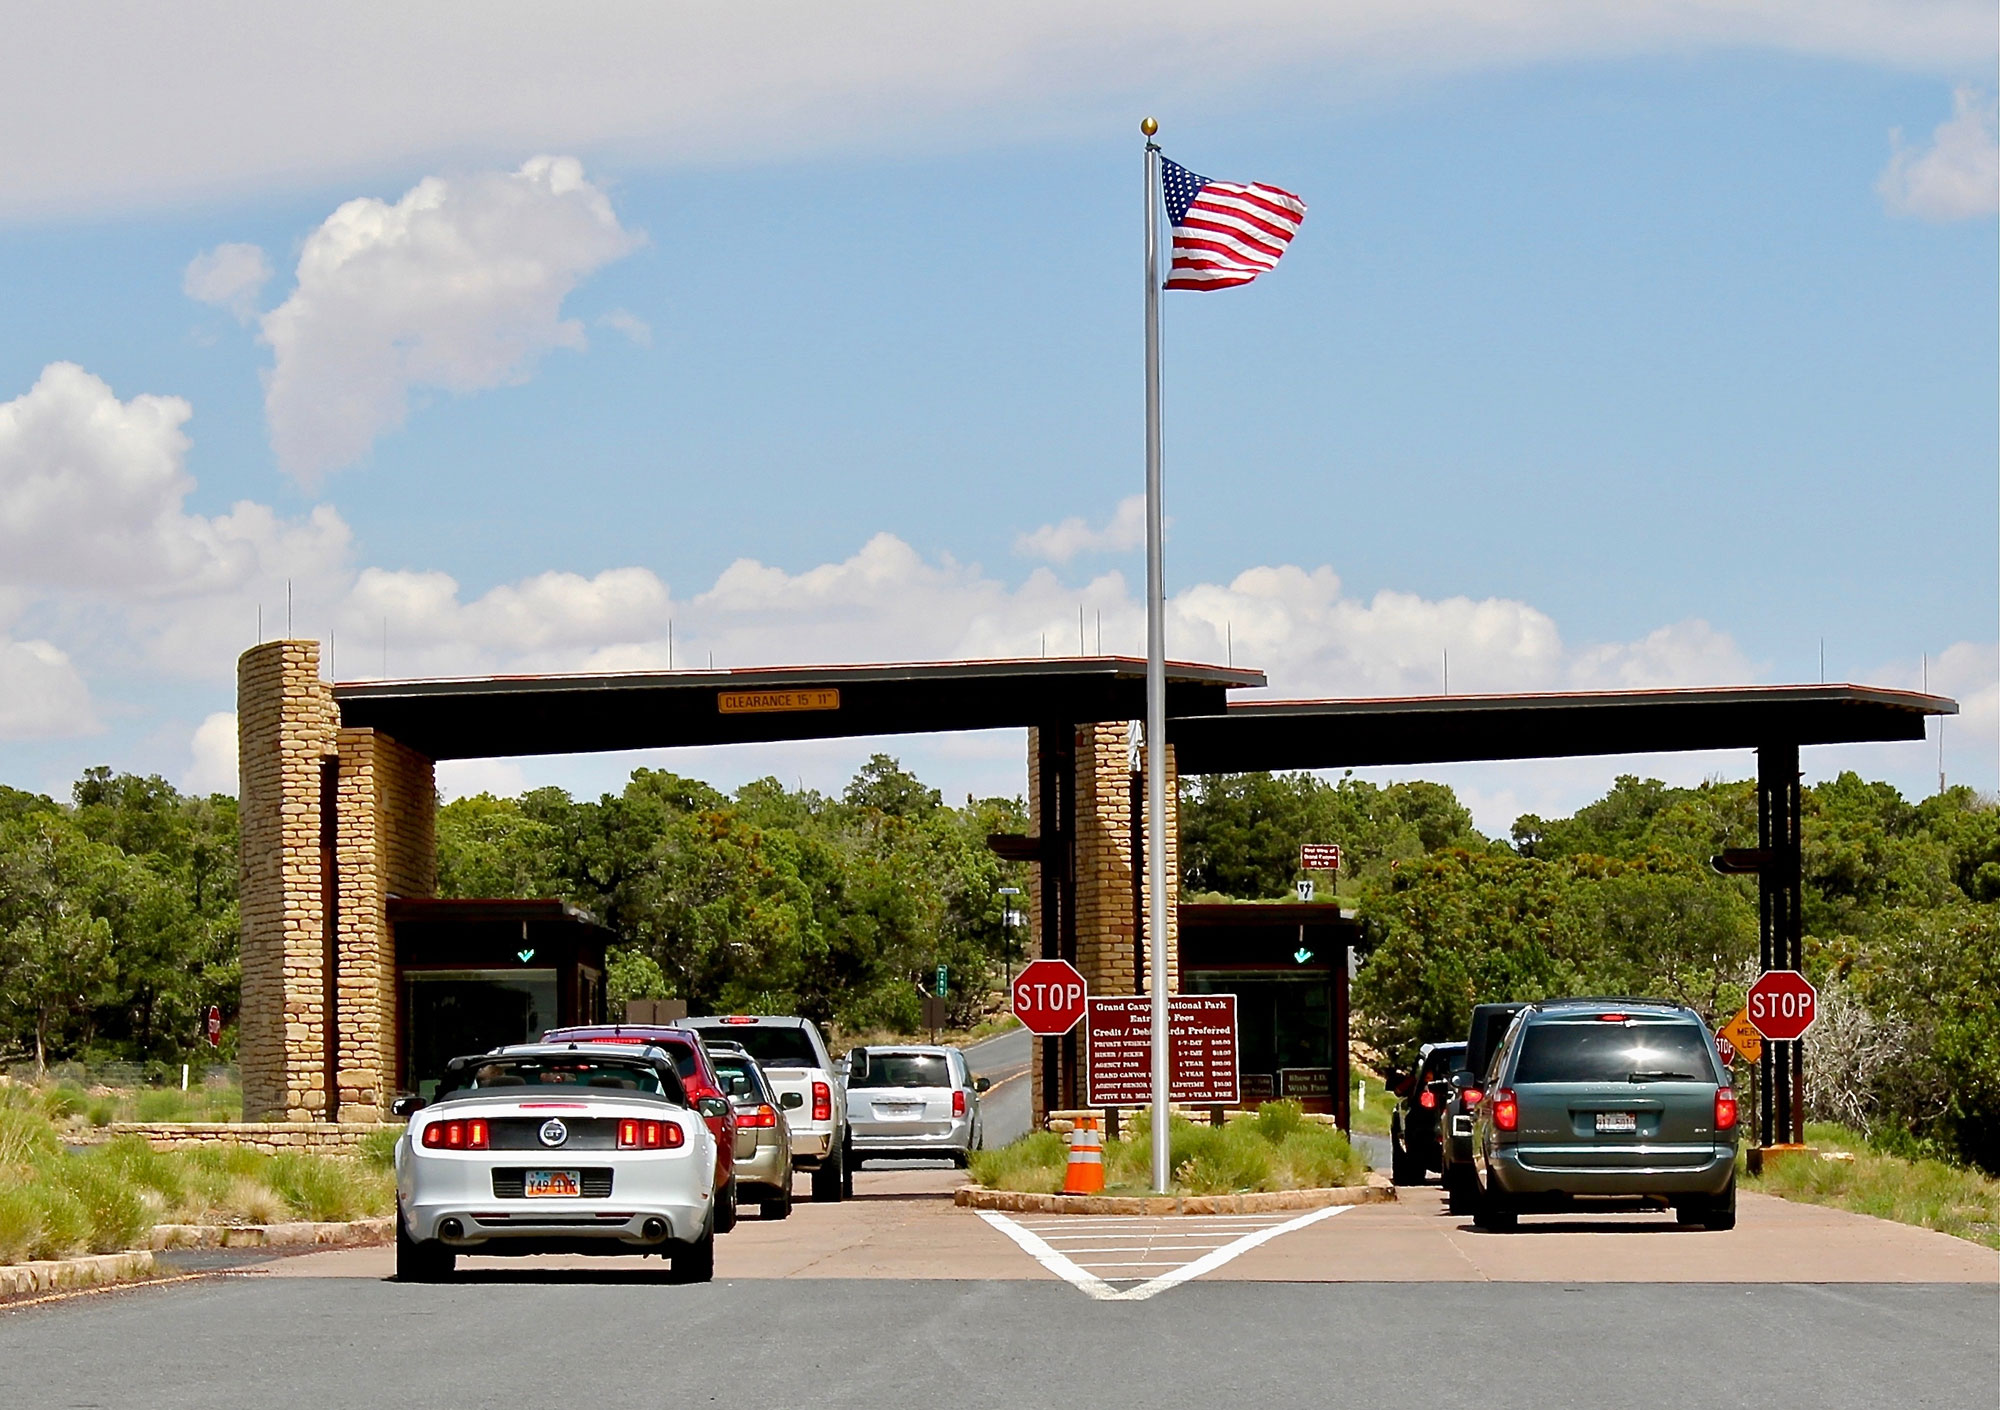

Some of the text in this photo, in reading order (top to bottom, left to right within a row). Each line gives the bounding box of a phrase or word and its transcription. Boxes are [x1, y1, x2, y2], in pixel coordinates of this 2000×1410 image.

[726, 694, 792, 708] CLEARANCE
[797, 694, 812, 706] 15'
[1017, 983, 1080, 1011] STOP
[1096, 1003, 1124, 1011] Grand
[1127, 1003, 1152, 1012] Cany
[1205, 1001, 1226, 1009] Park
[1752, 992, 1811, 1018] STOP
[1124, 1028, 1129, 1036] /
[1168, 1027, 1184, 1035] rds
[1188, 1026, 1230, 1035] Preferred
[1737, 1027, 1761, 1036] MER
[1716, 1038, 1733, 1054] STOP
[530, 1180, 549, 1193] Y49
